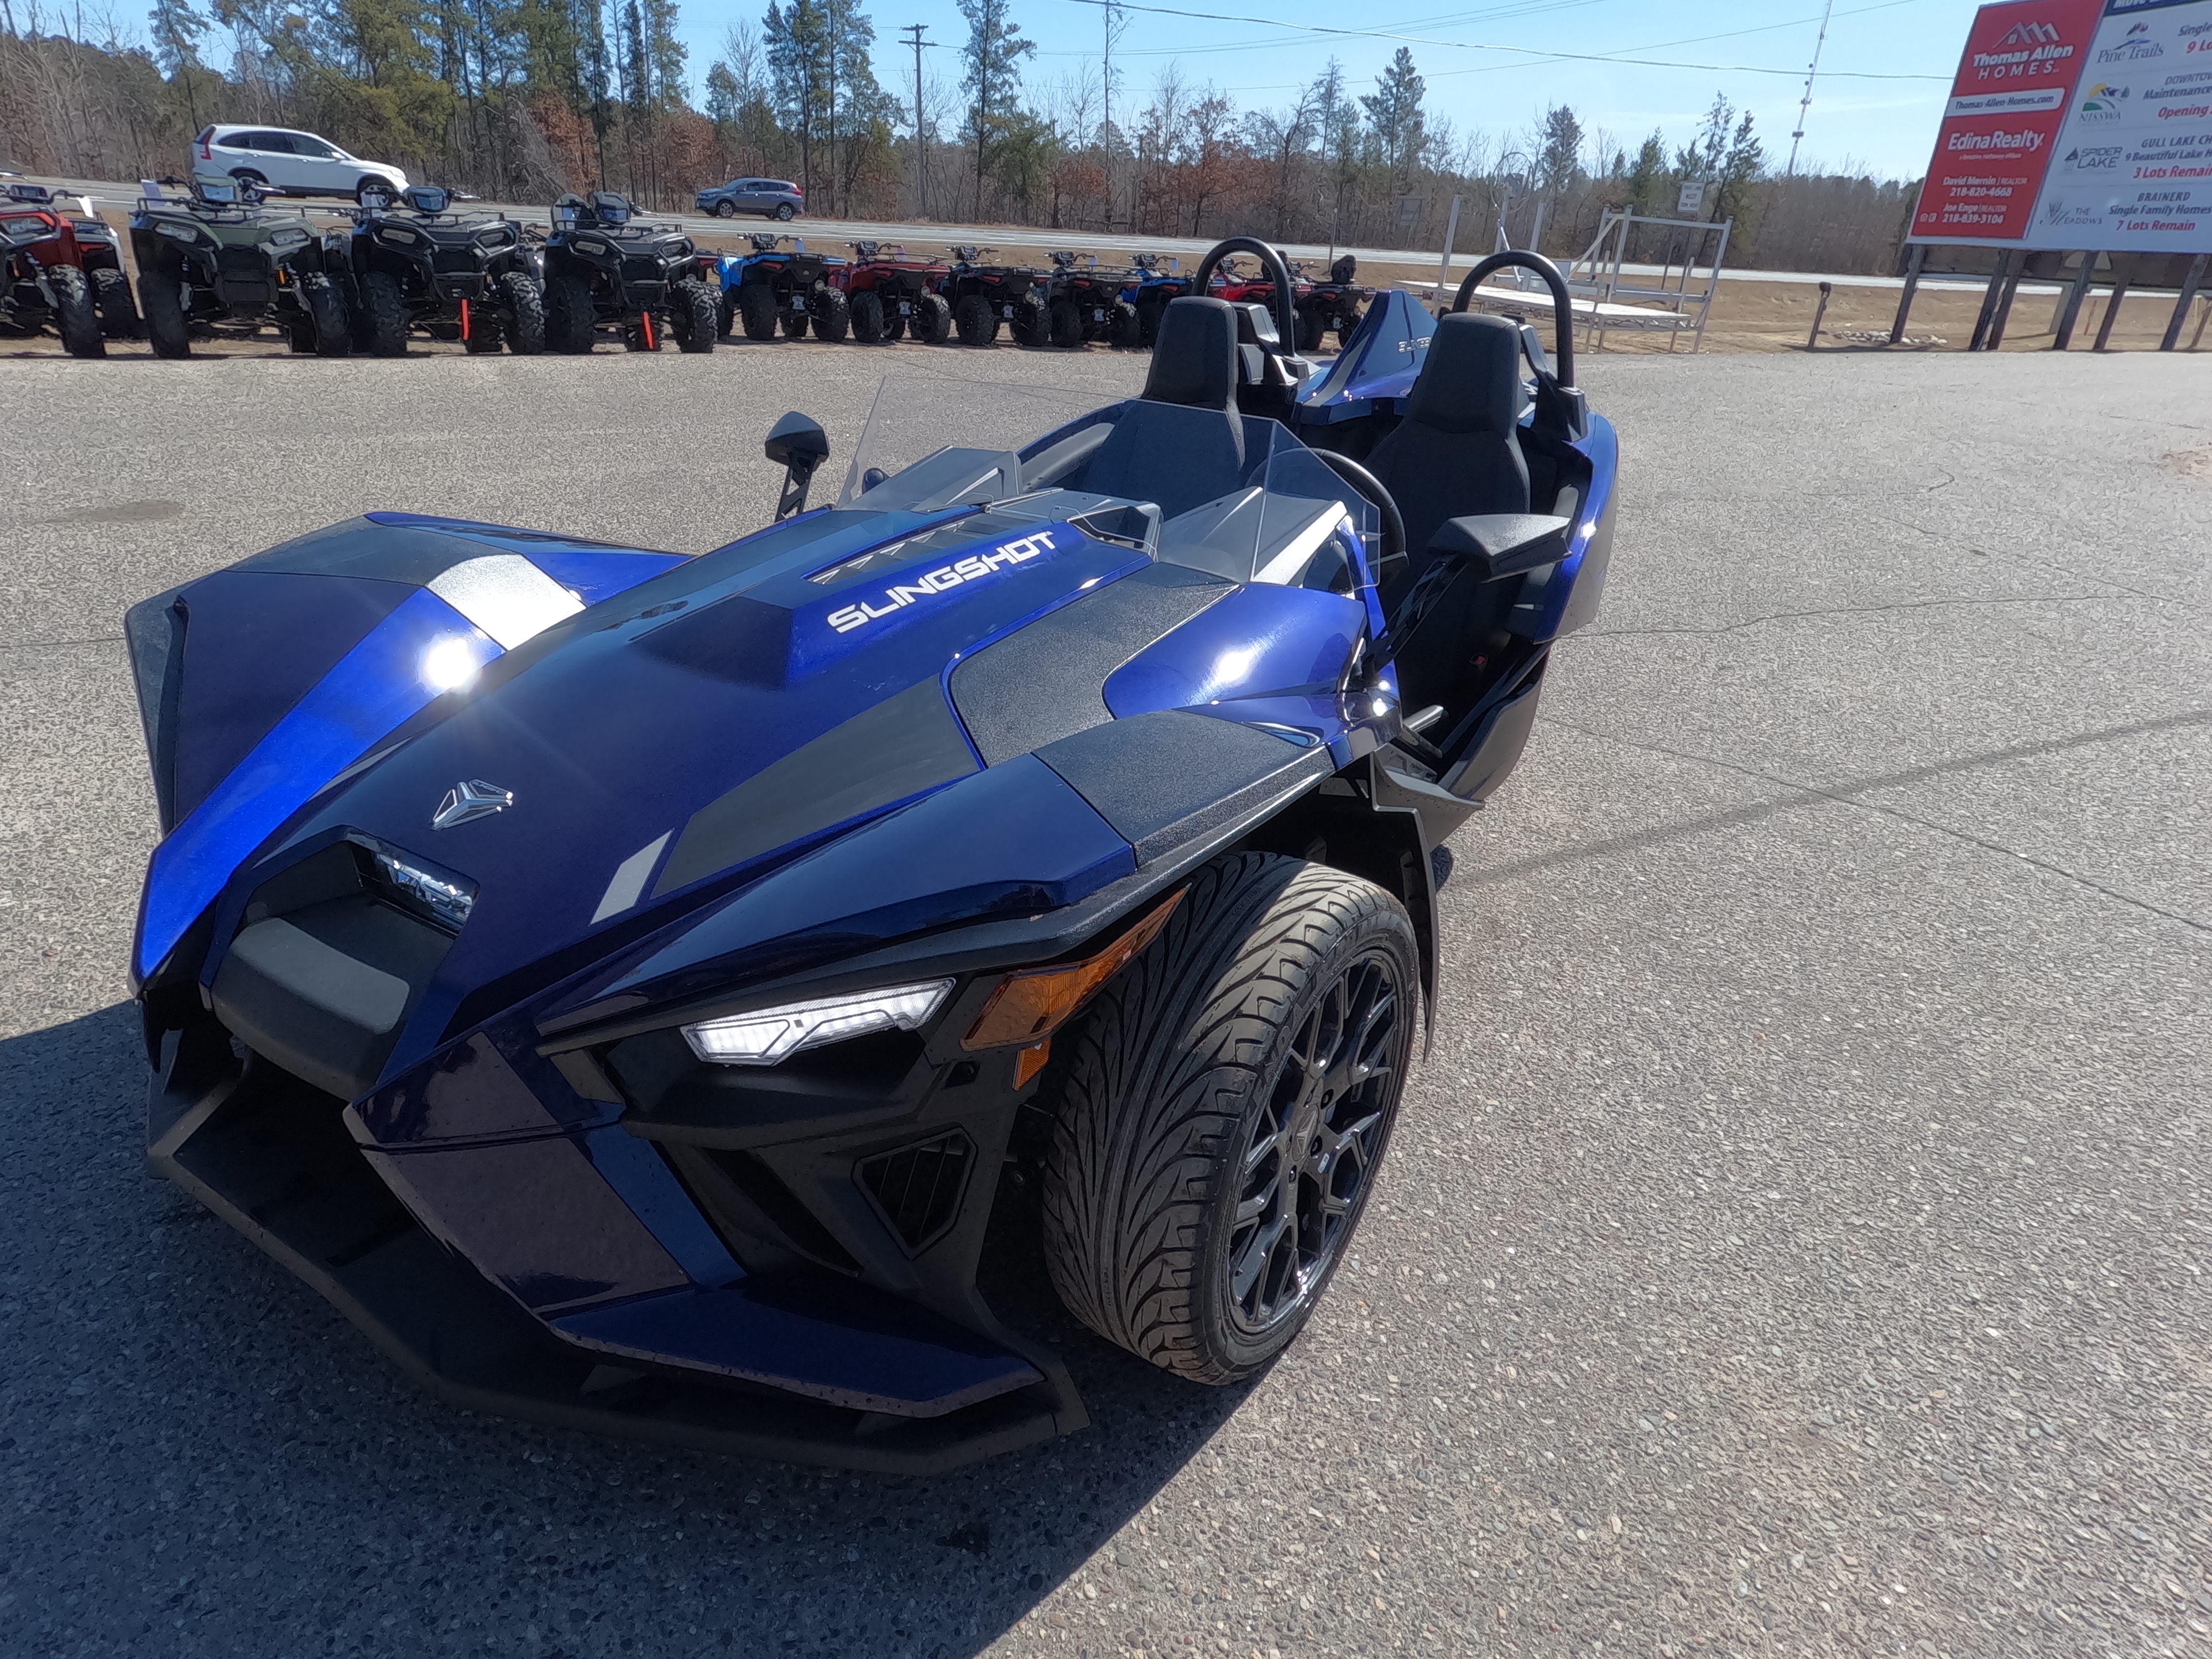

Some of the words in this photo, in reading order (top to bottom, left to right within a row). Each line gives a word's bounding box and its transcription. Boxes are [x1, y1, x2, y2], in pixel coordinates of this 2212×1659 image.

[2186, 40, 2197, 54] 9
[1973, 50, 2030, 67] Thomas
[2030, 45, 2074, 61] Allen
[2096, 49, 2125, 64] Pine
[2128, 43, 2164, 60] Trails
[1978, 60, 2054, 80] HOMES
[1955, 96, 2054, 109] Thomas-Allen-Homes.com
[2158, 104, 2209, 119] Opening
[2141, 138, 2166, 148] GULL
[2169, 137, 2195, 146] LAKE
[2080, 147, 2123, 157] SPIDER
[2125, 152, 2131, 161] 9
[2132, 150, 2178, 161] Beautiful
[2179, 149, 2203, 159] Lake
[2077, 157, 2119, 169] LAKE
[2133, 167, 2141, 179] 3
[2142, 166, 2166, 179] Lots
[1943, 176, 1965, 185] David
[2137, 192, 2190, 202] BRAINERD
[1943, 202, 1955, 212] Joe
[1958, 203, 1978, 213] Enge
[2108, 205, 2138, 217] Single
[2140, 205, 2174, 217] Family
[2176, 205, 2212, 215] Homes
[2116, 220, 2124, 231] 7
[2126, 220, 2149, 231] Lots
[2151, 220, 2196, 231] Remain
[827, 531, 1055, 634] SLINGSHOT
